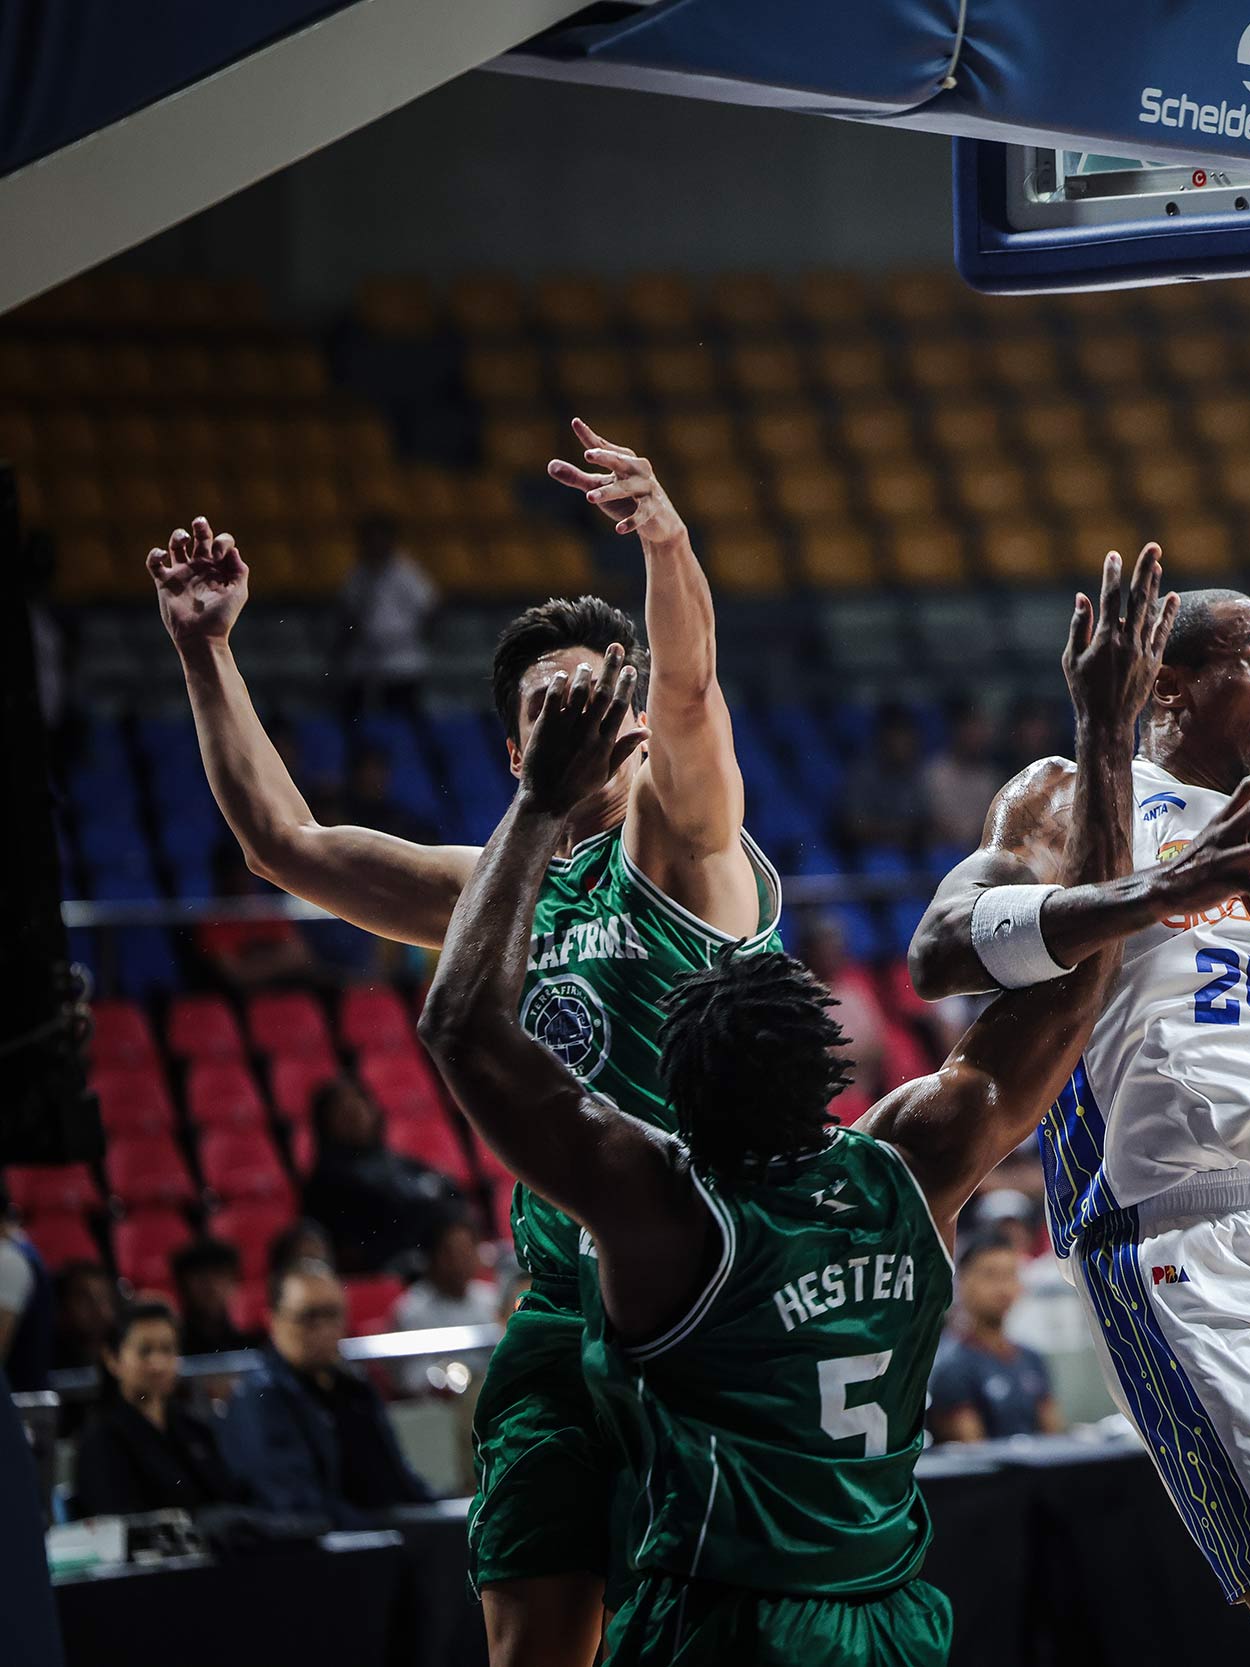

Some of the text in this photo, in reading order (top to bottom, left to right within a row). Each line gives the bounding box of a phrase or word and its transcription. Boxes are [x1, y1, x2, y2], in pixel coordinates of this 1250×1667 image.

[1143, 803, 1169, 822] ANTA
[773, 1254, 915, 1333] HESTER
[1151, 1264, 1191, 1285] PBA
[816, 1349, 893, 1458] 5
